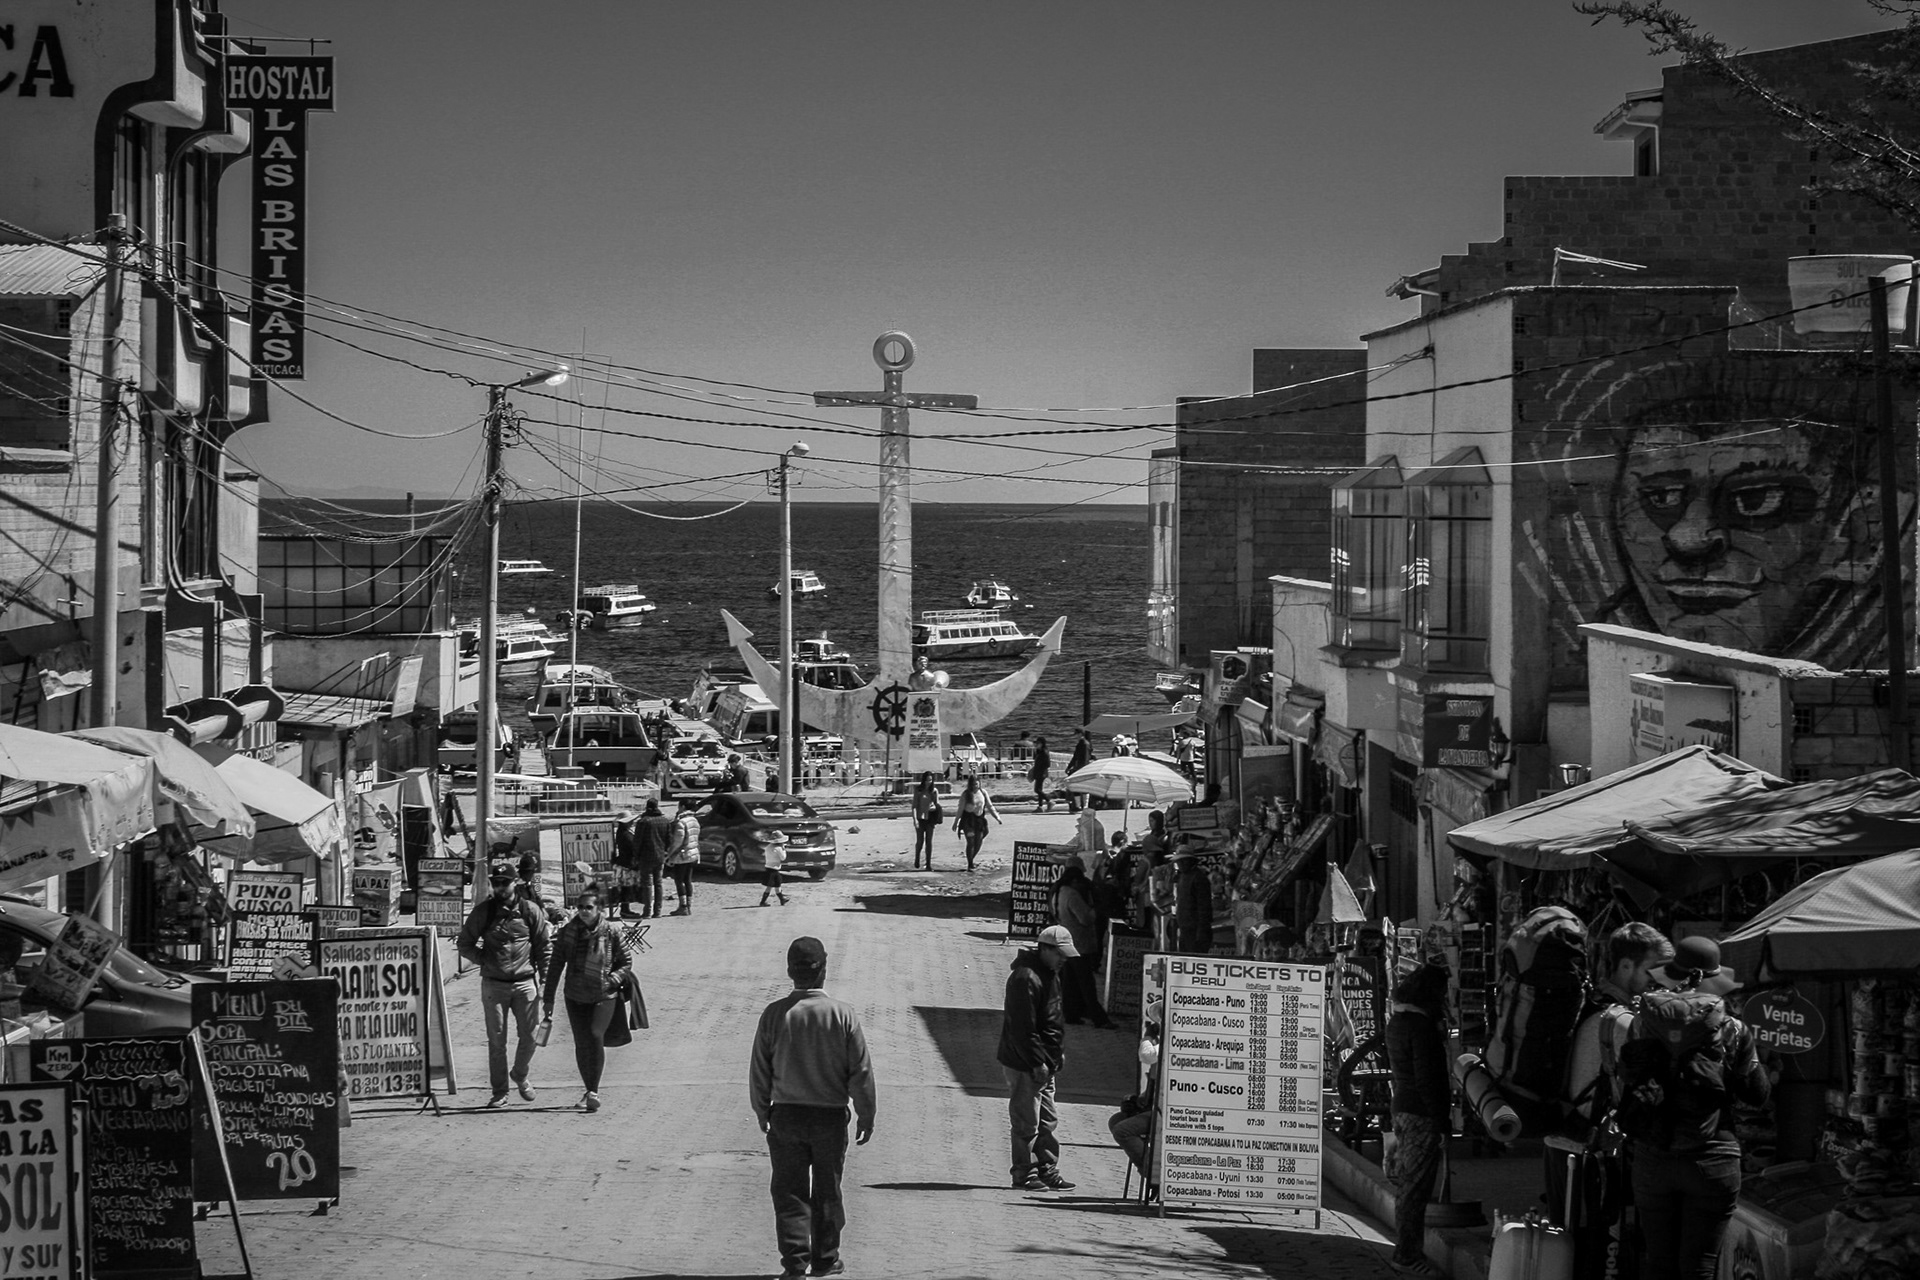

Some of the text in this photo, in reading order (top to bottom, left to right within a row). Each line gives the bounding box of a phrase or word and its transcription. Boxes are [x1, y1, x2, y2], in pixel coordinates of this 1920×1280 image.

[228, 65, 332, 100] HOSTAL
[258, 108, 298, 362] LAS BRISAS
[1457, 724, 1471, 742] DE
[1438, 748, 1489, 768] LAVANDERIA
[1017, 845, 1047, 854] Salidas
[1016, 852, 1046, 861] diarias
[1015, 861, 1050, 883] ISLA DEL
[355, 877, 389, 890] LA PAZ
[236, 884, 291, 899] PUNO
[1012, 890, 1028, 899] ISLA
[235, 899, 293, 912] CUSCO
[447, 902, 461, 913] SOL
[1013, 900, 1032, 910] ISLAS
[247, 914, 303, 927] HOSTAL
[1014, 912, 1026, 923] Hrs
[235, 919, 267, 939] BRISAS
[280, 921, 313, 941] TITICACA
[1011, 924, 1033, 934] MONEY
[238, 940, 308, 949] TE OFRECE
[323, 942, 419, 963] Salidas diarias
[1171, 961, 1322, 982] BUS TICKETS TO
[363, 962, 420, 998] DEL SOL
[1192, 976, 1226, 987] PERU
[1172, 991, 1246, 1009] Copacabana Puno
[1249, 992, 1268, 1000] 09:00
[1281, 994, 1299, 1002] 11:00
[211, 990, 267, 1017] MENU
[272, 1000, 308, 1017] DEL
[354, 1001, 408, 1012] norte y sur
[1281, 1001, 1299, 1009] 15:30
[1249, 1006, 1268, 1014] 18:30
[1281, 1008, 1299, 1016] 20:30
[1762, 1003, 1805, 1026] Venta
[273, 1014, 308, 1027] DIA
[355, 1012, 418, 1040] DE LA LUNA
[1172, 1012, 1245, 1029] Copacabana Cusco
[199, 1019, 247, 1042] SOPA
[1249, 1029, 1268, 1037] 18:30
[1751, 1024, 1812, 1048] Tarjetas
[1171, 1035, 1244, 1054] Copacabana Arequipa
[1249, 1037, 1267, 1045] 09:00
[1280, 1039, 1298, 1047] 19:00
[362, 1042, 422, 1060] FLOTANTES
[1249, 1044, 1267, 1052] 13:00
[1280, 1046, 1298, 1054] 23:00
[48, 1049, 69, 1063] KM
[1280, 1053, 1298, 1061] 05:00
[47, 1063, 73, 1072] ZERO
[385, 1059, 423, 1073] PRIVADOS
[1171, 1054, 1245, 1070] Copacabana Lima
[1249, 1060, 1266, 1068] 13:30
[208, 1061, 256, 1084] POLLO
[257, 1064, 265, 1076] A
[267, 1064, 282, 1078] LA
[1248, 1075, 1266, 1083] 08:00
[1279, 1077, 1297, 1085] 15:00
[75, 1068, 190, 1111] MENU 25
[1169, 1079, 1244, 1096] Puno Cusco
[1248, 1082, 1266, 1090] 13:00
[1279, 1084, 1297, 1092] 19:00
[263, 1091, 336, 1108] ALBONDIGAS
[1247, 1096, 1266, 1104] 21:00
[1279, 1091, 1297, 1099] 22:00
[1247, 1103, 1266, 1111] 22:00
[1278, 1098, 1297, 1106] 05:00
[274, 1106, 315, 1121] LIMON
[1184, 1108, 1202, 1116] Cusco
[91, 1109, 189, 1133] VEGETARIANO
[1246, 1119, 1265, 1127] 07:30
[1279, 1121, 1298, 1129] 17:30
[1212, 1124, 1225, 1132] tops
[19, 1129, 58, 1155] LA
[259, 1132, 305, 1150] FRUTAS
[1165, 1135, 1320, 1154] DESDE FROM COPACABANA A TO LA PAZ CONECTION IN BOLIVIA
[1166, 1152, 1242, 1168] Copacabana La Paz
[1246, 1156, 1264, 1164] 13:30
[1278, 1158, 1296, 1166] 17:30
[265, 1148, 317, 1192] 20
[1246, 1163, 1264, 1171] 18:30
[1277, 1165, 1296, 1173] 22:00
[1167, 1169, 1240, 1184] Copacabana Uyuni
[1246, 1175, 1264, 1183] 13:30
[1277, 1177, 1296, 1185] 07:00
[1166, 1184, 1240, 1198] Copacabana Potosi
[1245, 1190, 1264, 1198] 13:30
[1277, 1192, 1296, 1200] 05:00
[95, 1209, 166, 1226] VERDURAS
[3, 1246, 14, 1274] y
[21, 1243, 62, 1270] sur
